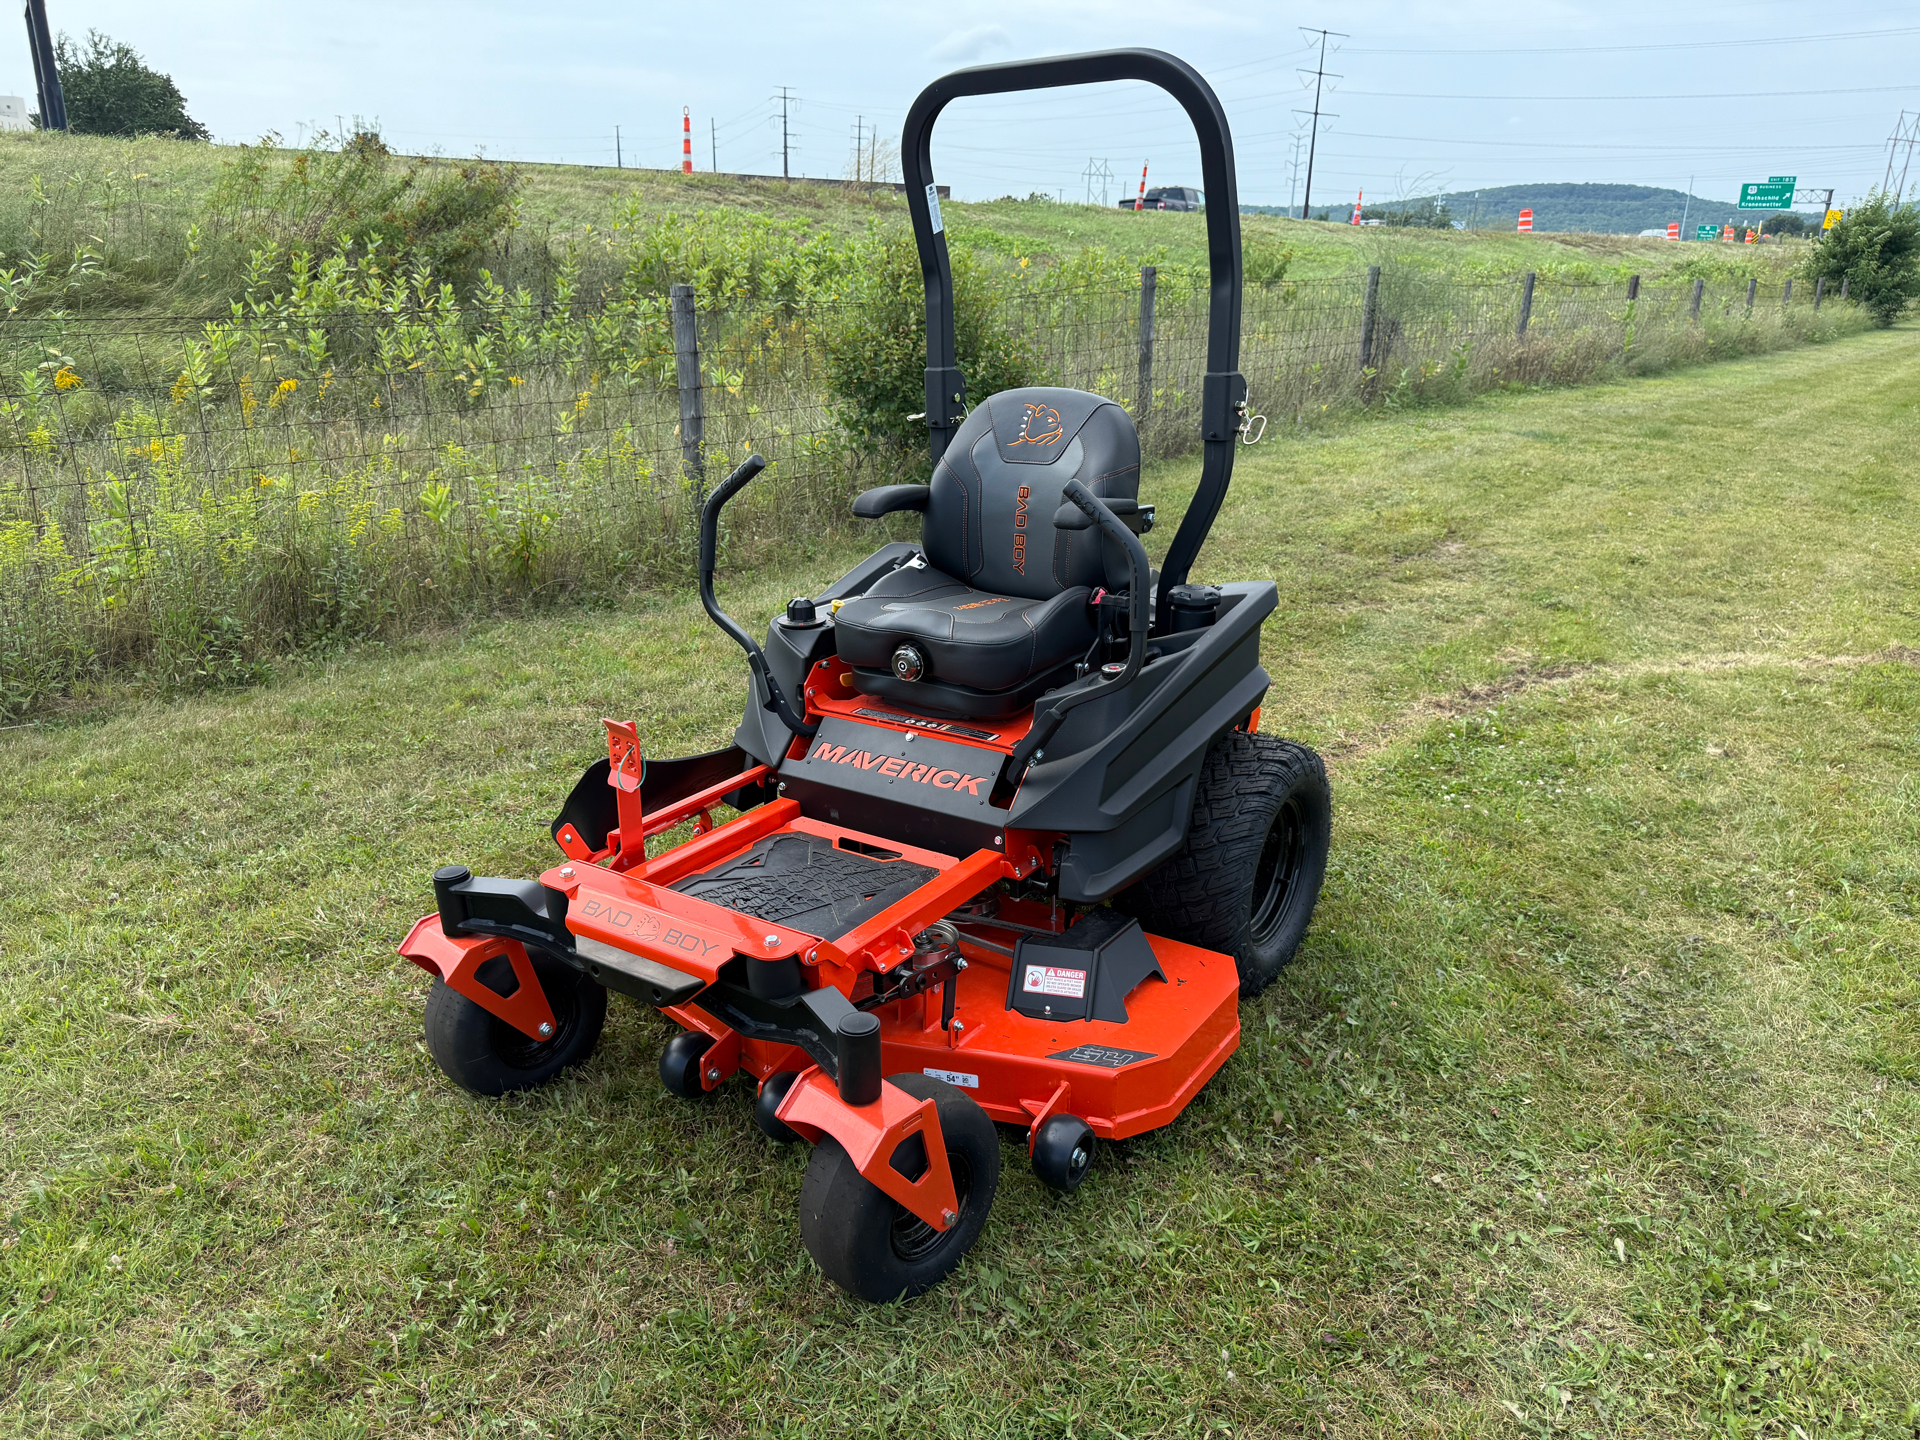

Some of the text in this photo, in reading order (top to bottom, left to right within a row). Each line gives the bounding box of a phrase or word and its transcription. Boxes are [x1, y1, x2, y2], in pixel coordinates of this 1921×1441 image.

[1013, 485, 1031, 576] BAD BOY
[811, 742, 989, 796] MAVERICK
[581, 899, 720, 957] BAD BOY
[1057, 970, 1084, 979] DANGER
[1069, 1047, 1134, 1066] 54
